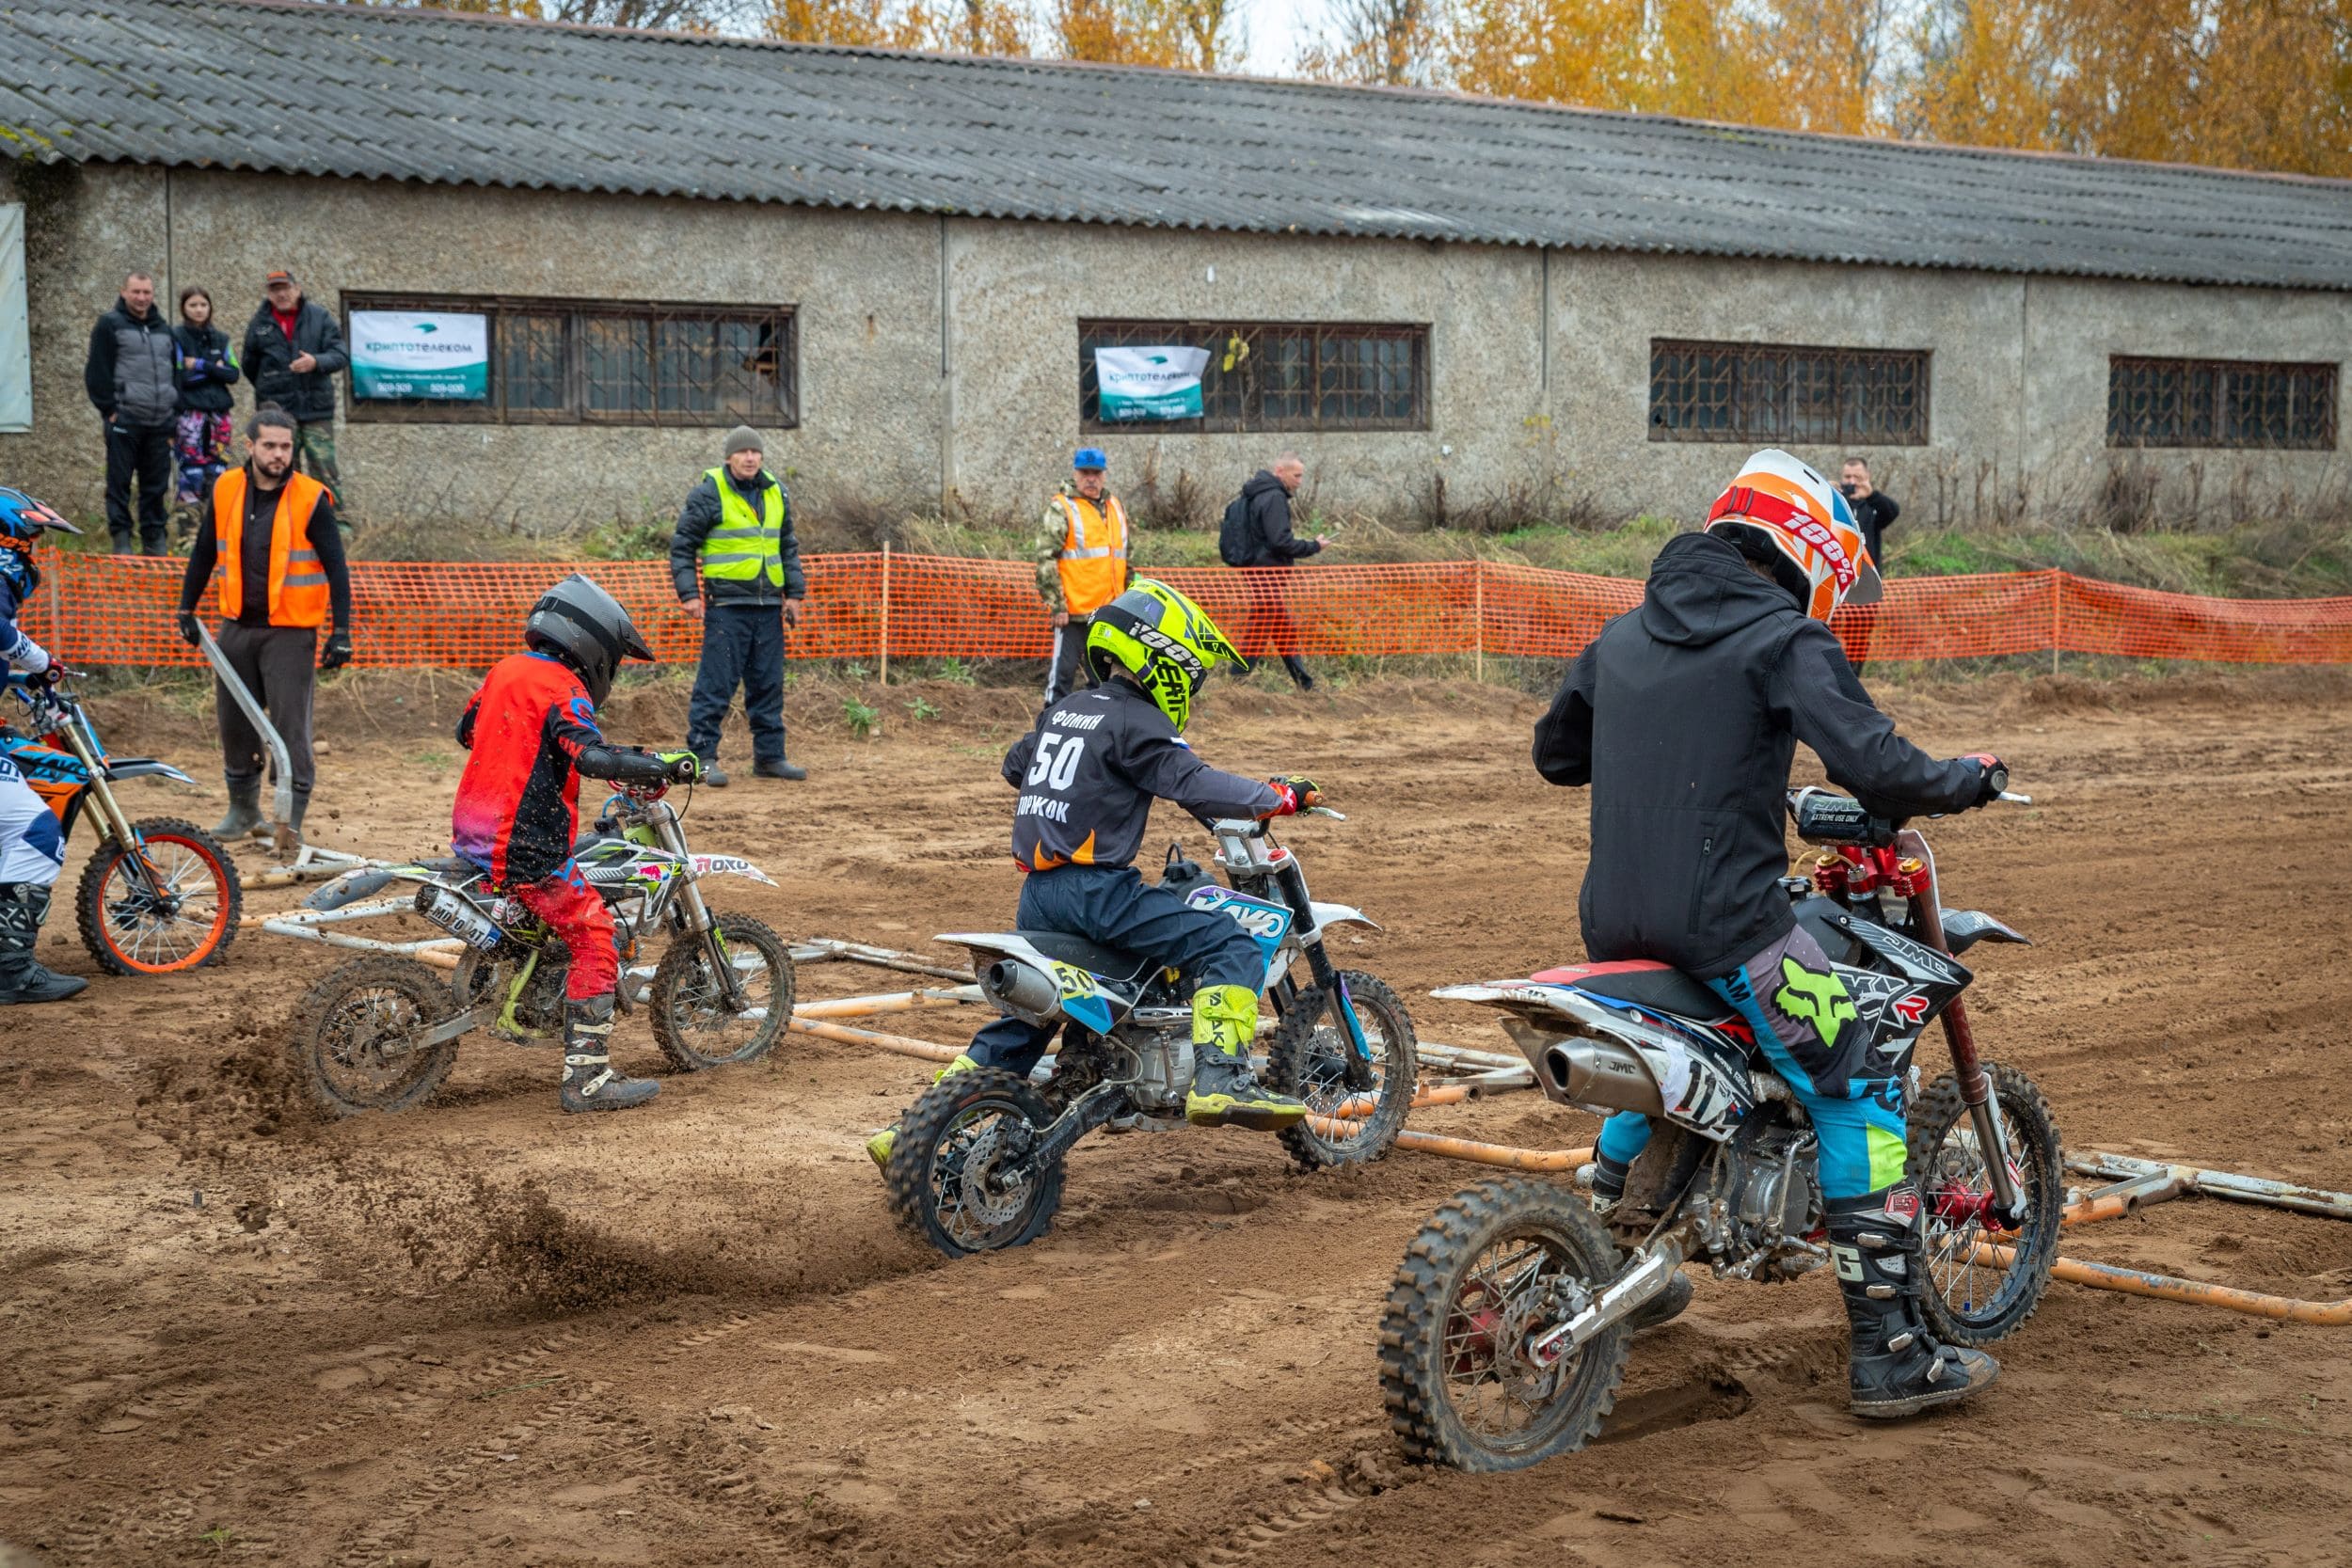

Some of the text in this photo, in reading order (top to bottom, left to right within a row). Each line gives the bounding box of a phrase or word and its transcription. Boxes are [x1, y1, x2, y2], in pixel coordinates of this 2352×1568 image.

[365, 341, 473, 354] криптотелеком
[1783, 511, 1852, 583] 100%
[1129, 621, 1202, 679] 100%
[1052, 709, 1105, 730] ФОМИН
[1028, 732, 1085, 791] 50
[1811, 813, 1859, 823] EXTREME USE ONLY
[1055, 967, 1096, 994] 50
[1609, 1061, 1636, 1075] JMC
